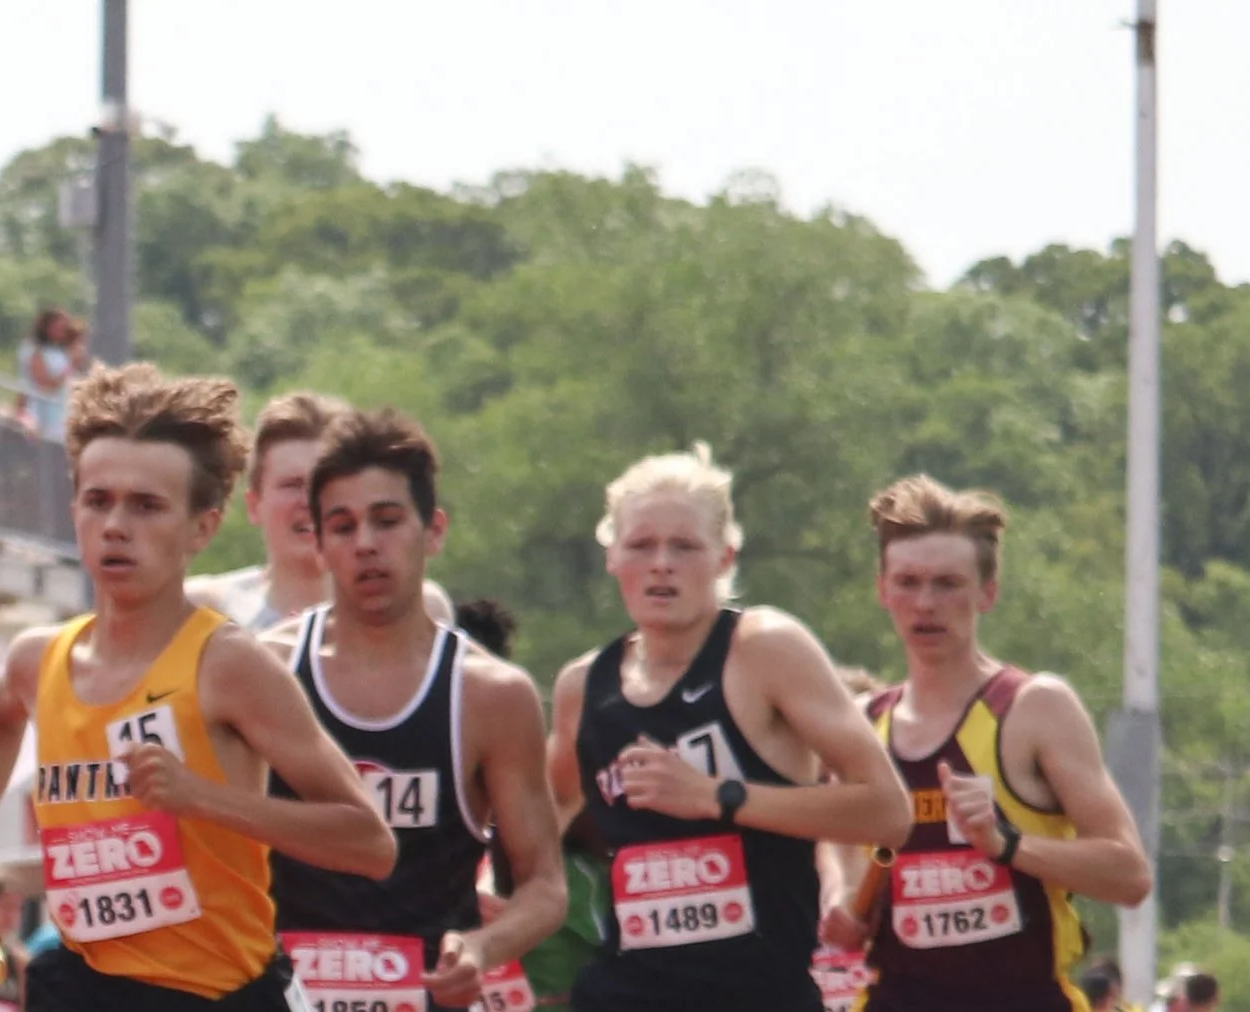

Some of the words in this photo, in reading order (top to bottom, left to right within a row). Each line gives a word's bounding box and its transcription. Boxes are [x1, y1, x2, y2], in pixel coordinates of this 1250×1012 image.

[687, 733, 717, 778] 7
[376, 776, 425, 824] 14
[48, 831, 162, 880] ZERO
[624, 852, 731, 895] ZERO
[901, 860, 997, 898] ZERO
[78, 888, 154, 927] 1831
[649, 903, 719, 934] 1489
[923, 908, 987, 936] 1762
[292, 947, 409, 982] ZERO
